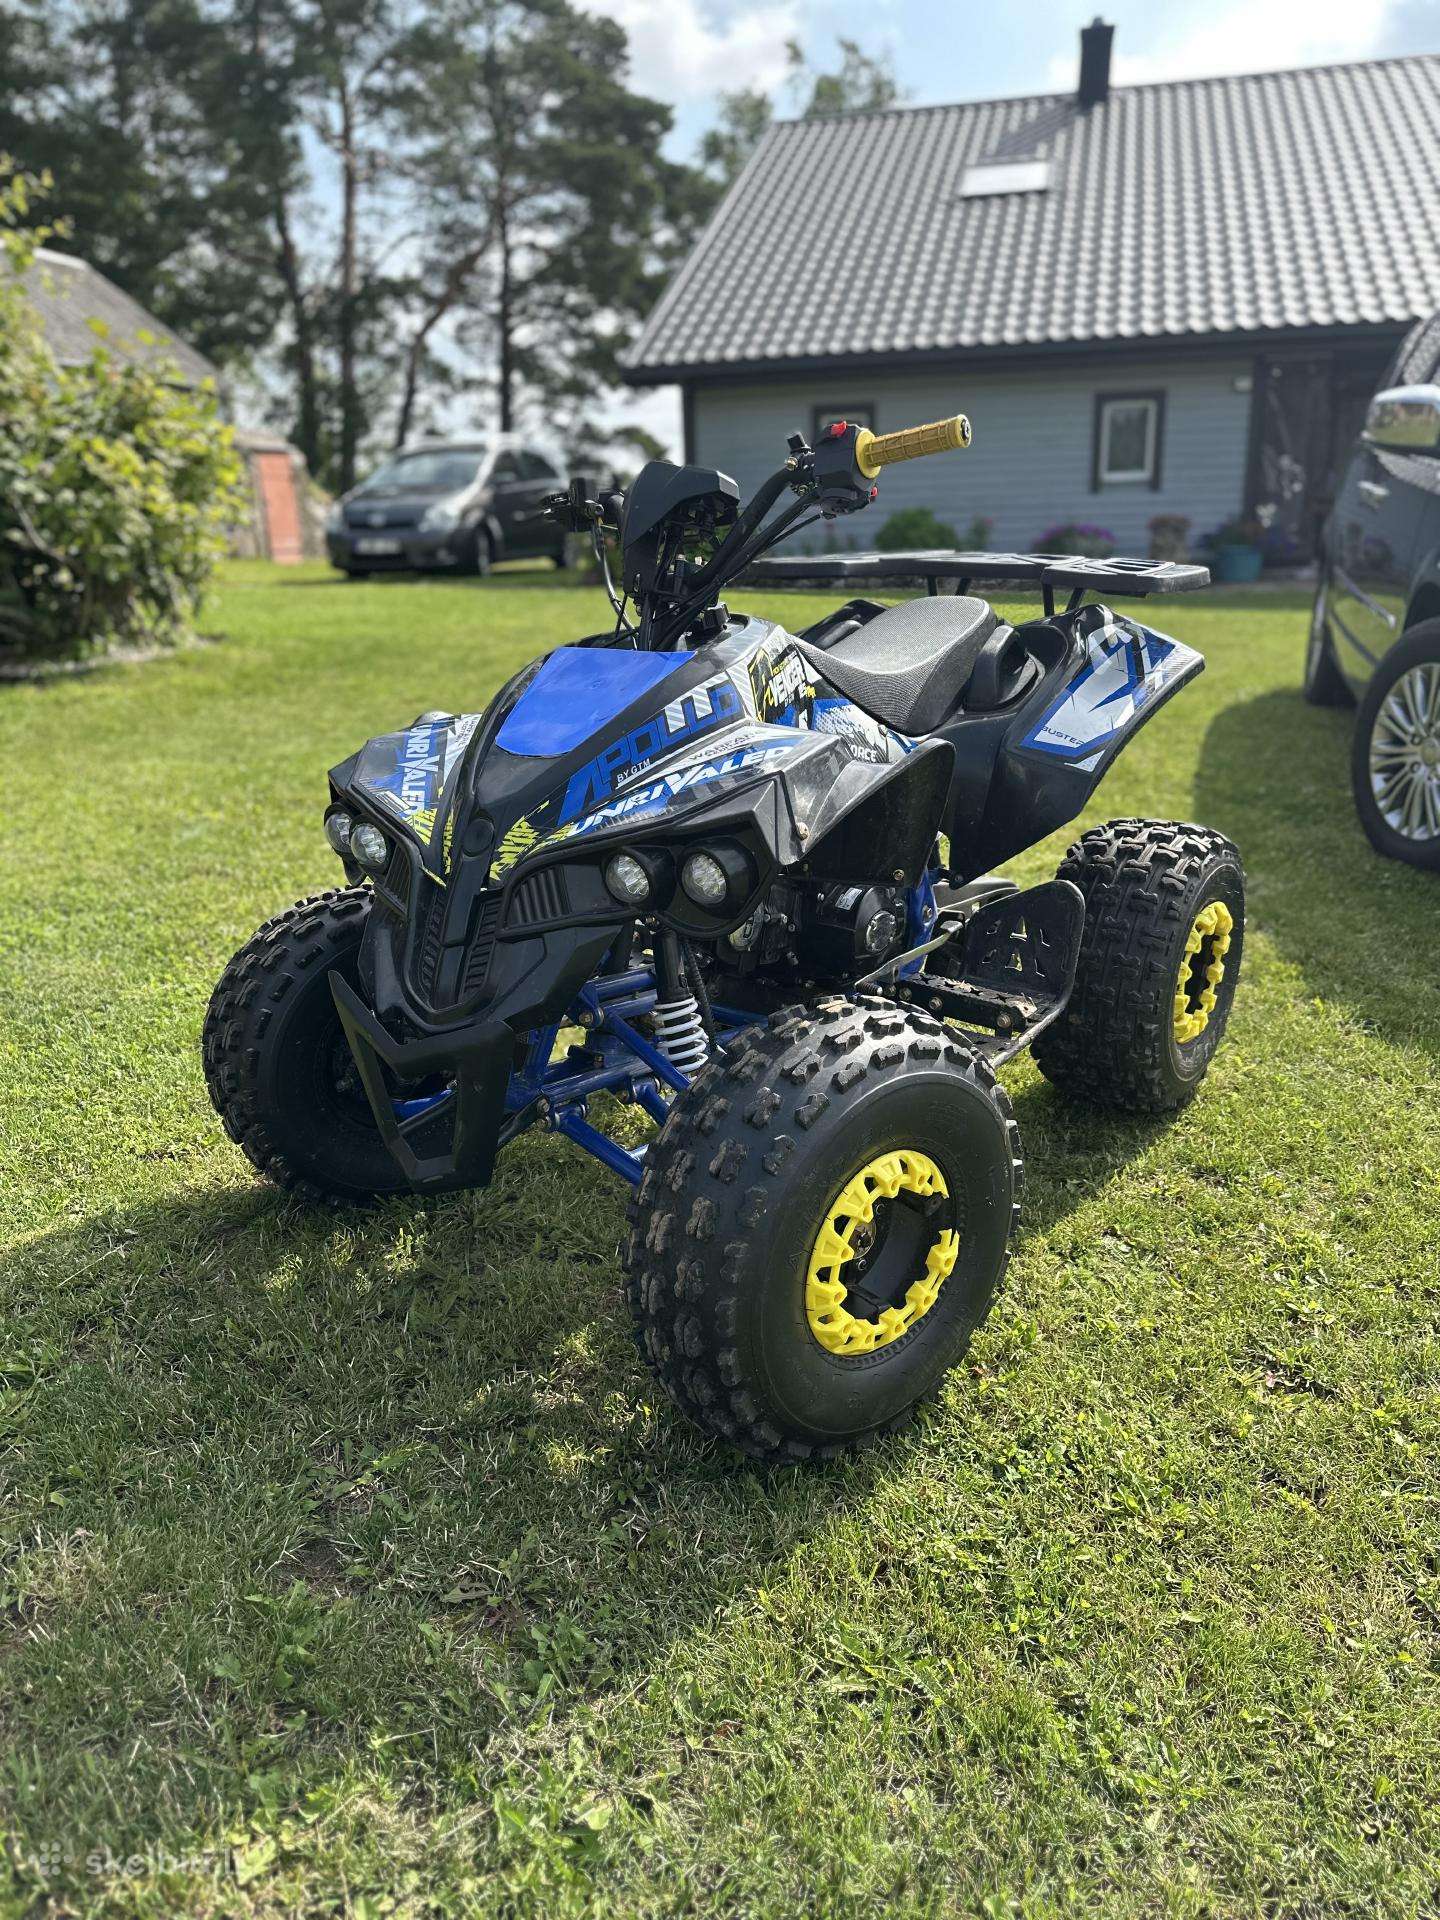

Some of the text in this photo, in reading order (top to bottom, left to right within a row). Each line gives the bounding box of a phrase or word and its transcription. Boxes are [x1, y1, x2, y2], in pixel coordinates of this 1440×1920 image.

[557, 681, 743, 826] APOLLO
[616, 757, 651, 782] BY GTM
[850, 745, 877, 762] ORCE
[568, 745, 795, 836] UNRIVALED
